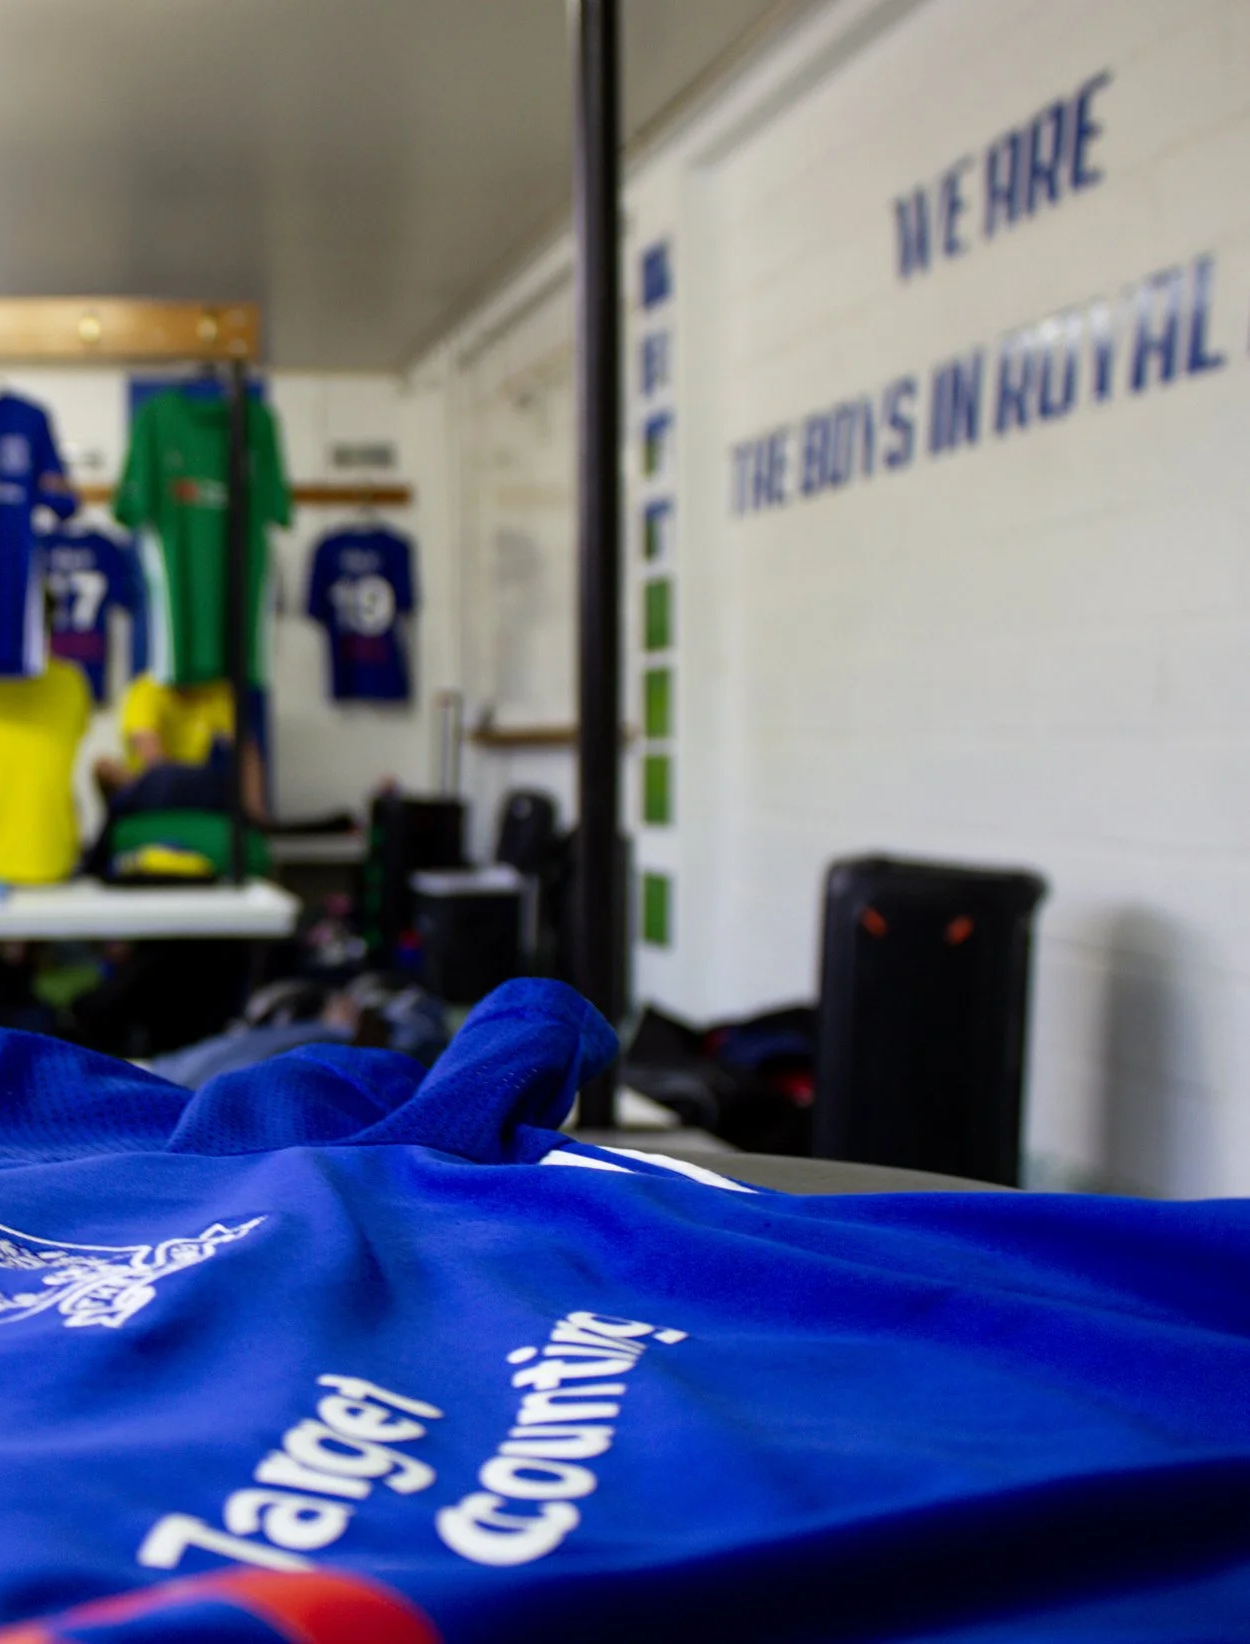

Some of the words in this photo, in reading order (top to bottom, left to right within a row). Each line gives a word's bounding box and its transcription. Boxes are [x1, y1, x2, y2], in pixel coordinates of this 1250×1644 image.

[892, 160, 972, 282] WE
[985, 70, 1112, 238] ARE
[729, 427, 791, 516] THE
[799, 376, 918, 496] BOYS
[928, 347, 985, 458] IN
[994, 250, 1226, 435] ROYAL
[328, 574, 396, 637] 19
